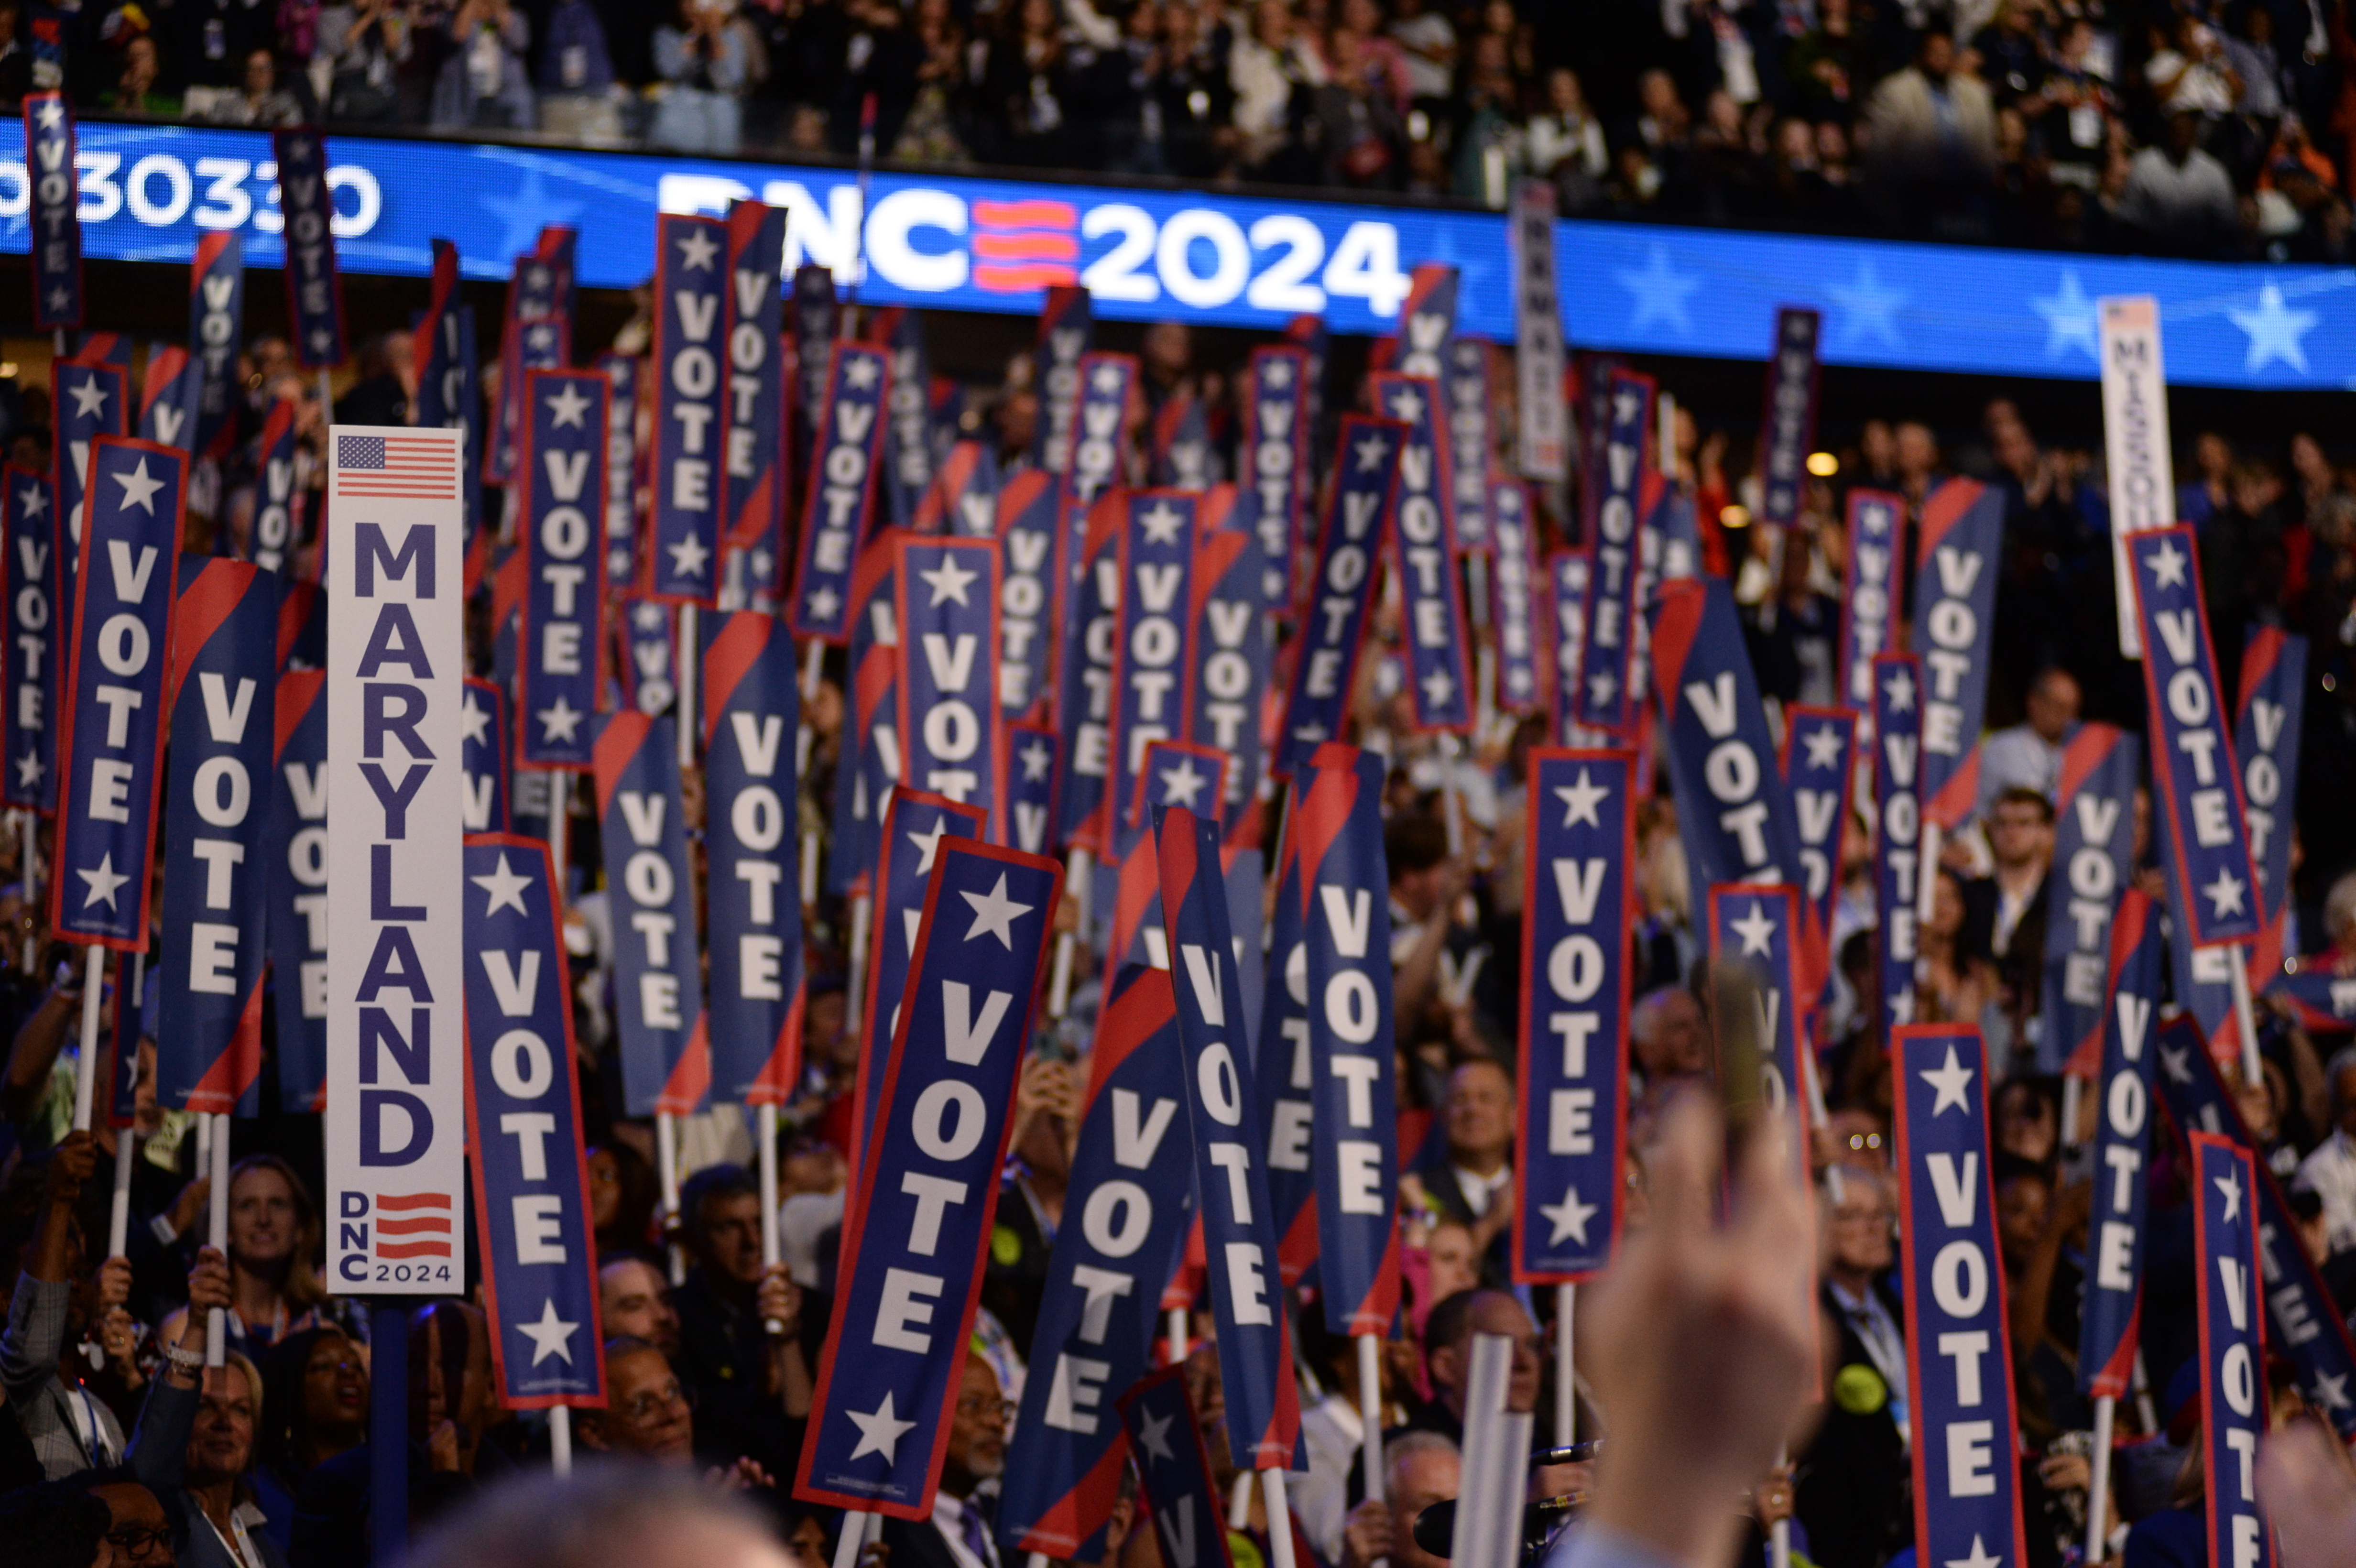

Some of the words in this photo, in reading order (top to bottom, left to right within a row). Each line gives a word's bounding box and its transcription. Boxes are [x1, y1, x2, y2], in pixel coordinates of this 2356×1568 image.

[36, 138, 69, 273] VOTE
[289, 175, 327, 314] VOTE
[1081, 203, 1414, 317] 2024
[201, 274, 234, 415] VOTE
[671, 292, 719, 511] VOTE
[726, 268, 770, 477] VOTE
[889, 345, 930, 486] VOTE
[1402, 313, 1448, 380] VO
[1451, 378, 1487, 501] VOTE
[255, 457, 293, 573] VO
[608, 400, 634, 537] VOTE
[813, 402, 874, 573] VOTE
[1076, 401, 1121, 502] VOT
[1257, 400, 1294, 556] VOTE
[1400, 446, 1448, 648] VOTE
[1594, 441, 1638, 647] VOTE
[16, 536, 49, 731] VOTE
[541, 450, 590, 675] VOTE
[1000, 529, 1049, 709] VOTE
[1306, 491, 1381, 697] VOTE
[1850, 544, 1890, 701] VOTE
[1922, 545, 1983, 759] VOTE
[88, 539, 158, 825] VOTE
[634, 641, 673, 718] VO
[922, 633, 979, 805] VOT
[1684, 671, 1783, 885] VOT
[2155, 609, 2235, 848] VOTE
[189, 672, 257, 995] VOTE
[284, 762, 328, 1019] VOTE
[355, 523, 437, 1167] MARYLAND
[730, 711, 784, 1001] VOTE
[1795, 788, 1839, 903] VO
[1883, 734, 1919, 962] VOTE
[2245, 697, 2286, 887] VOT
[618, 791, 682, 1030] VOTE
[2063, 793, 2121, 1007] VOTE
[479, 949, 567, 1265] VOTE
[1268, 941, 1313, 1172] TE
[1320, 884, 1385, 1216] VOTE
[1548, 859, 1608, 1156] VOTE
[339, 1191, 369, 1282] DNC
[872, 979, 1014, 1355] VOTE
[1181, 944, 1273, 1326] VOTE
[2097, 992, 2151, 1293] VOTE
[375, 1264, 452, 1282] 2024
[1043, 1088, 1178, 1434] VOTE
[1925, 1151, 1997, 1498] VOTE
[2218, 1256, 2261, 1568] VOTE
